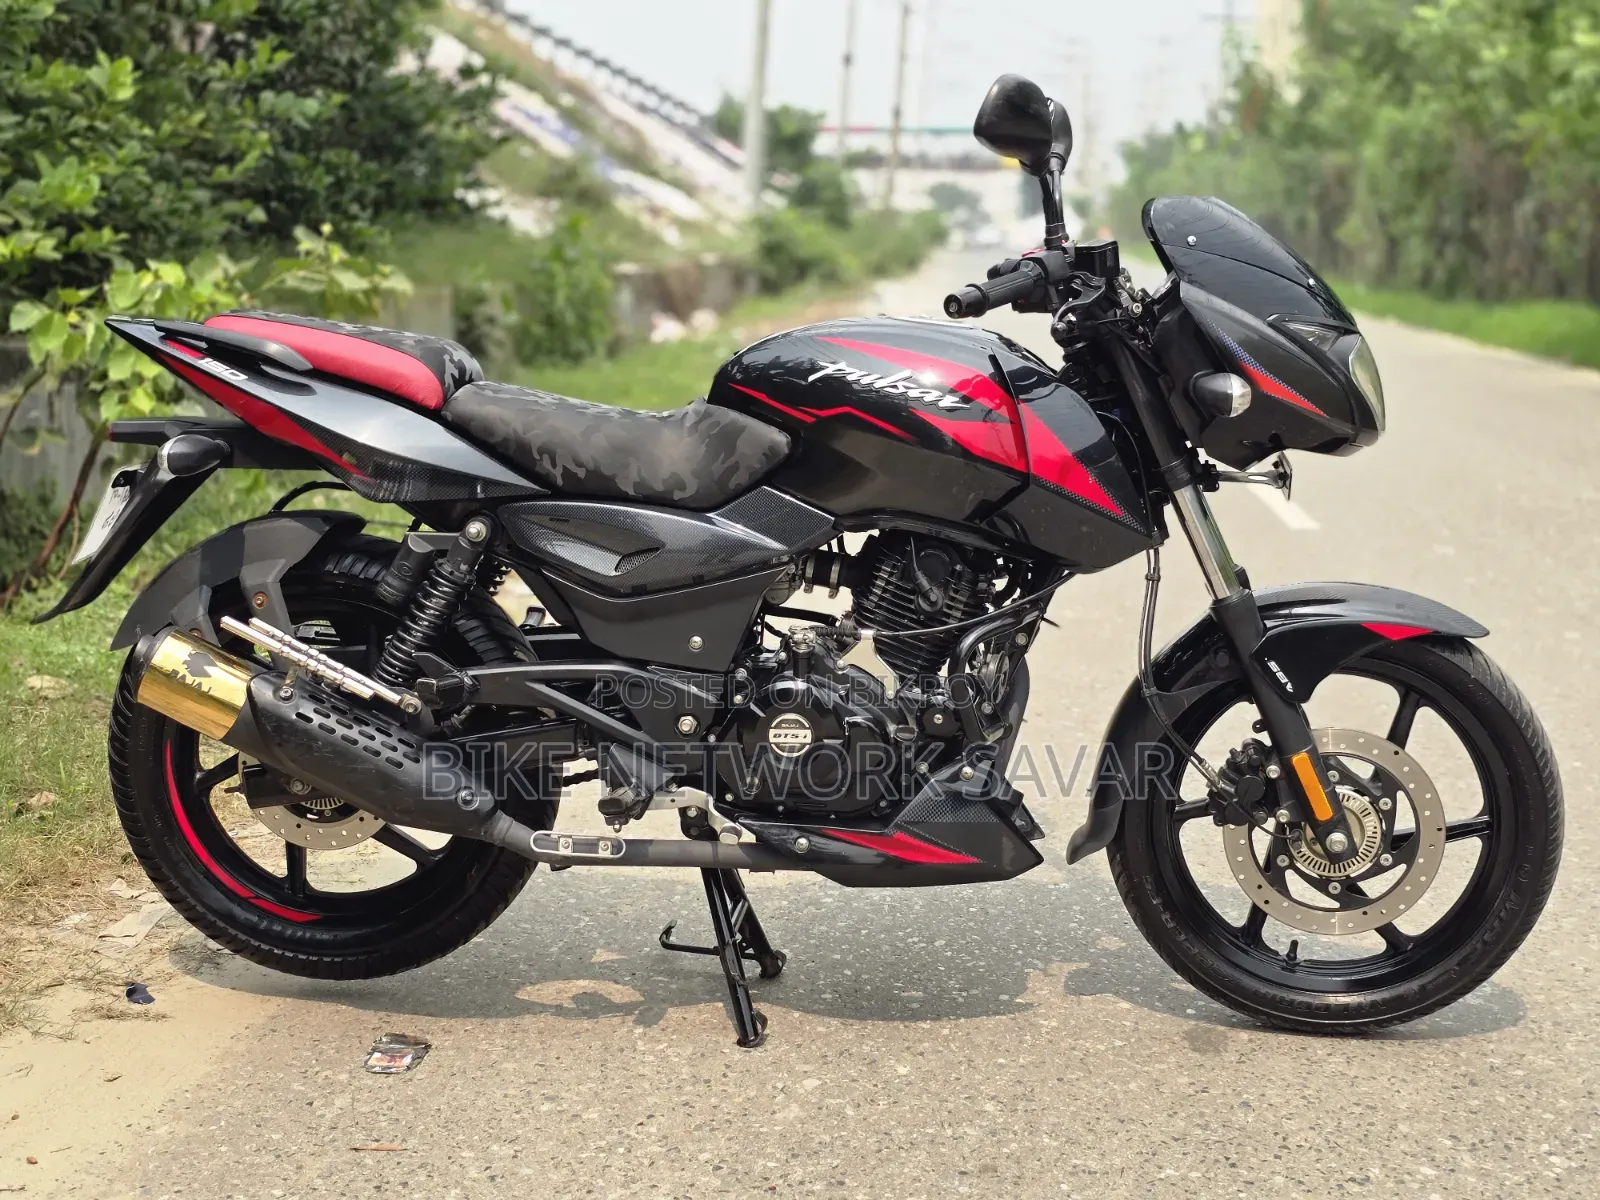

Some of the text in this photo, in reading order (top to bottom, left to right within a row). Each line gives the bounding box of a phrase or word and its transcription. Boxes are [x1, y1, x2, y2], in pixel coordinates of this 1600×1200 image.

[198, 357, 249, 381] 150
[170, 668, 213, 695] BAJAJ
[1266, 660, 1294, 693] ABS
